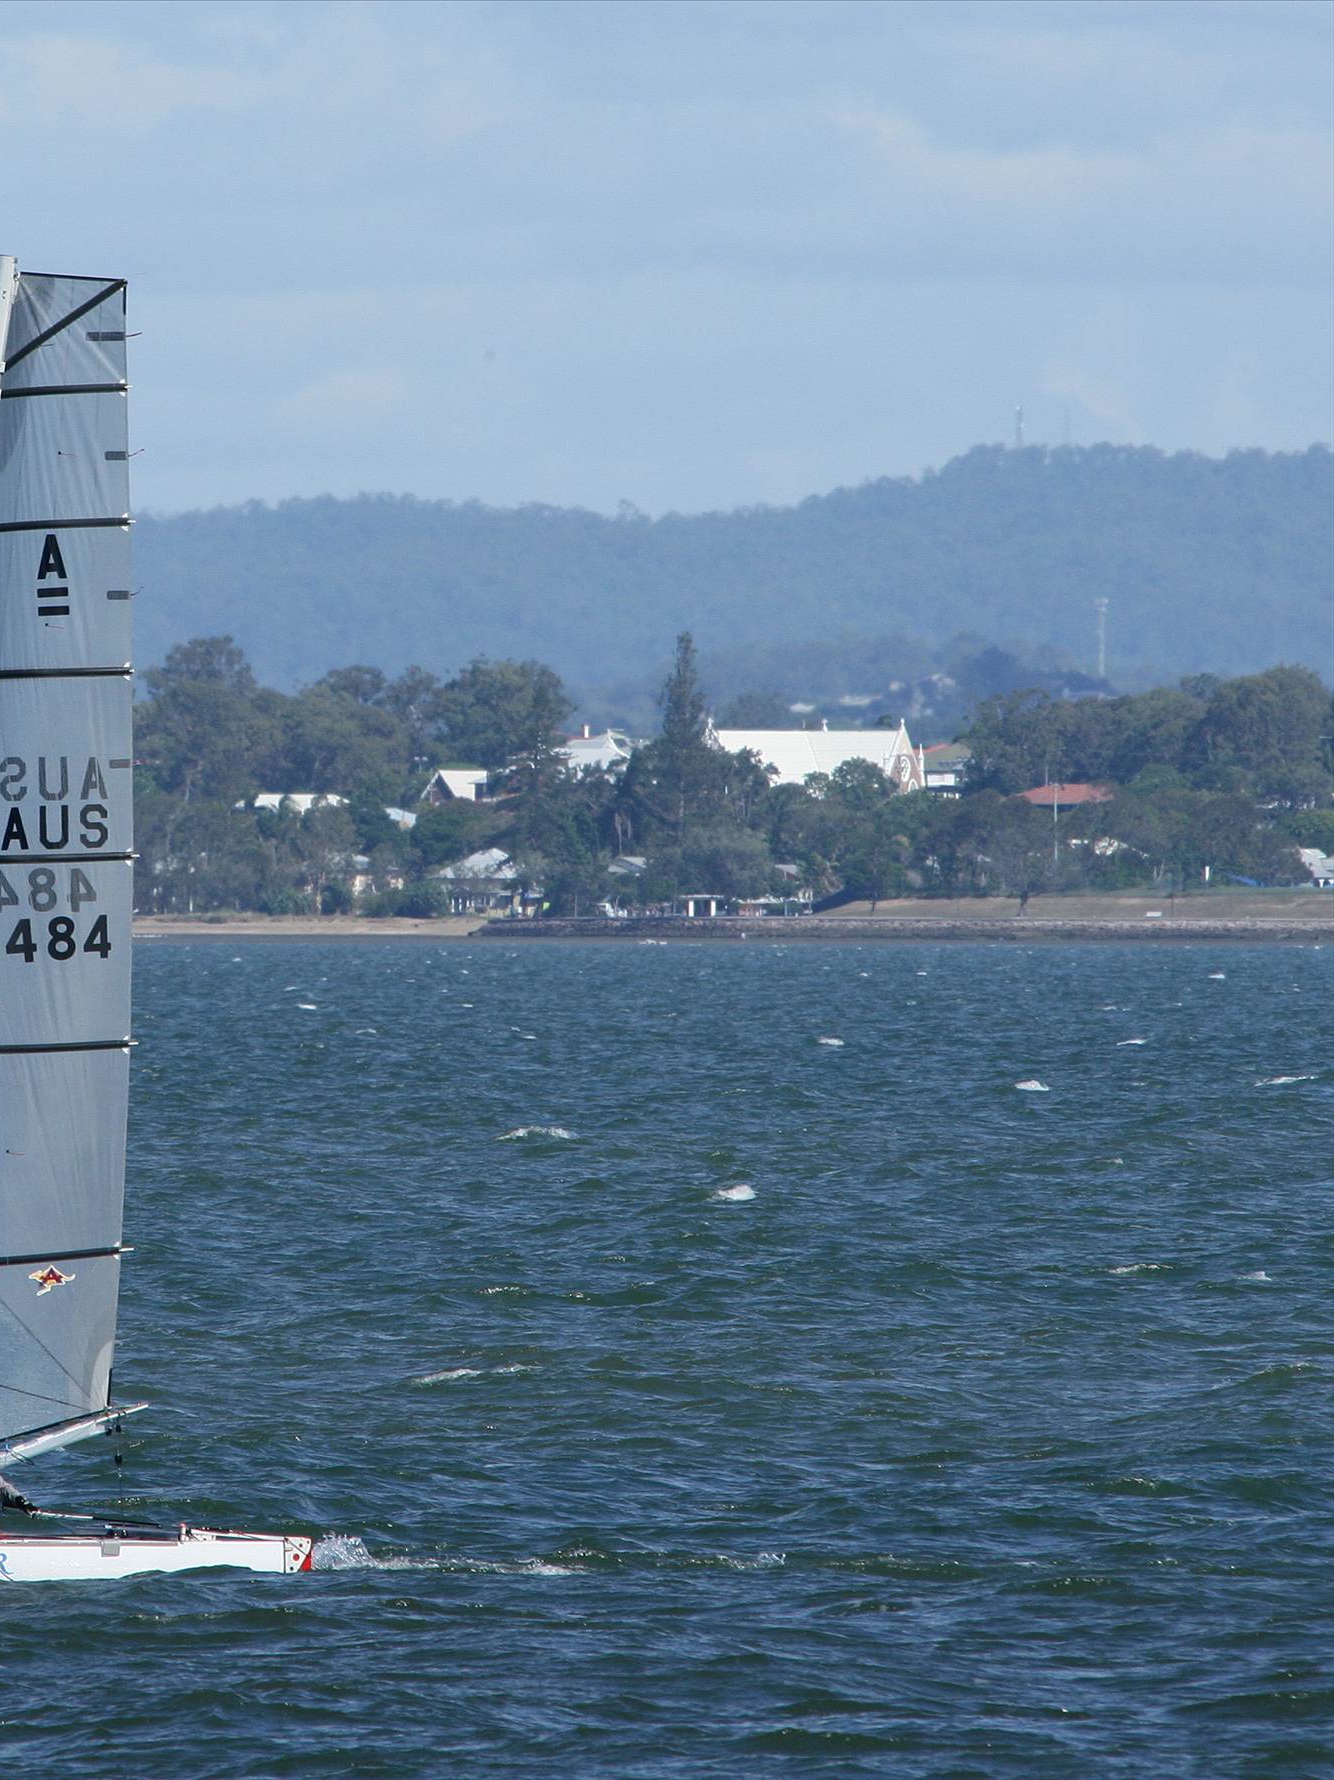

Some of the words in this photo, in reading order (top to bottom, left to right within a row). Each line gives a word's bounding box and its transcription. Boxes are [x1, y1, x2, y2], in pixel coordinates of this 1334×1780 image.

[37, 534, 68, 580] A
[1, 804, 109, 850] AUS
[6, 914, 111, 963] 484
